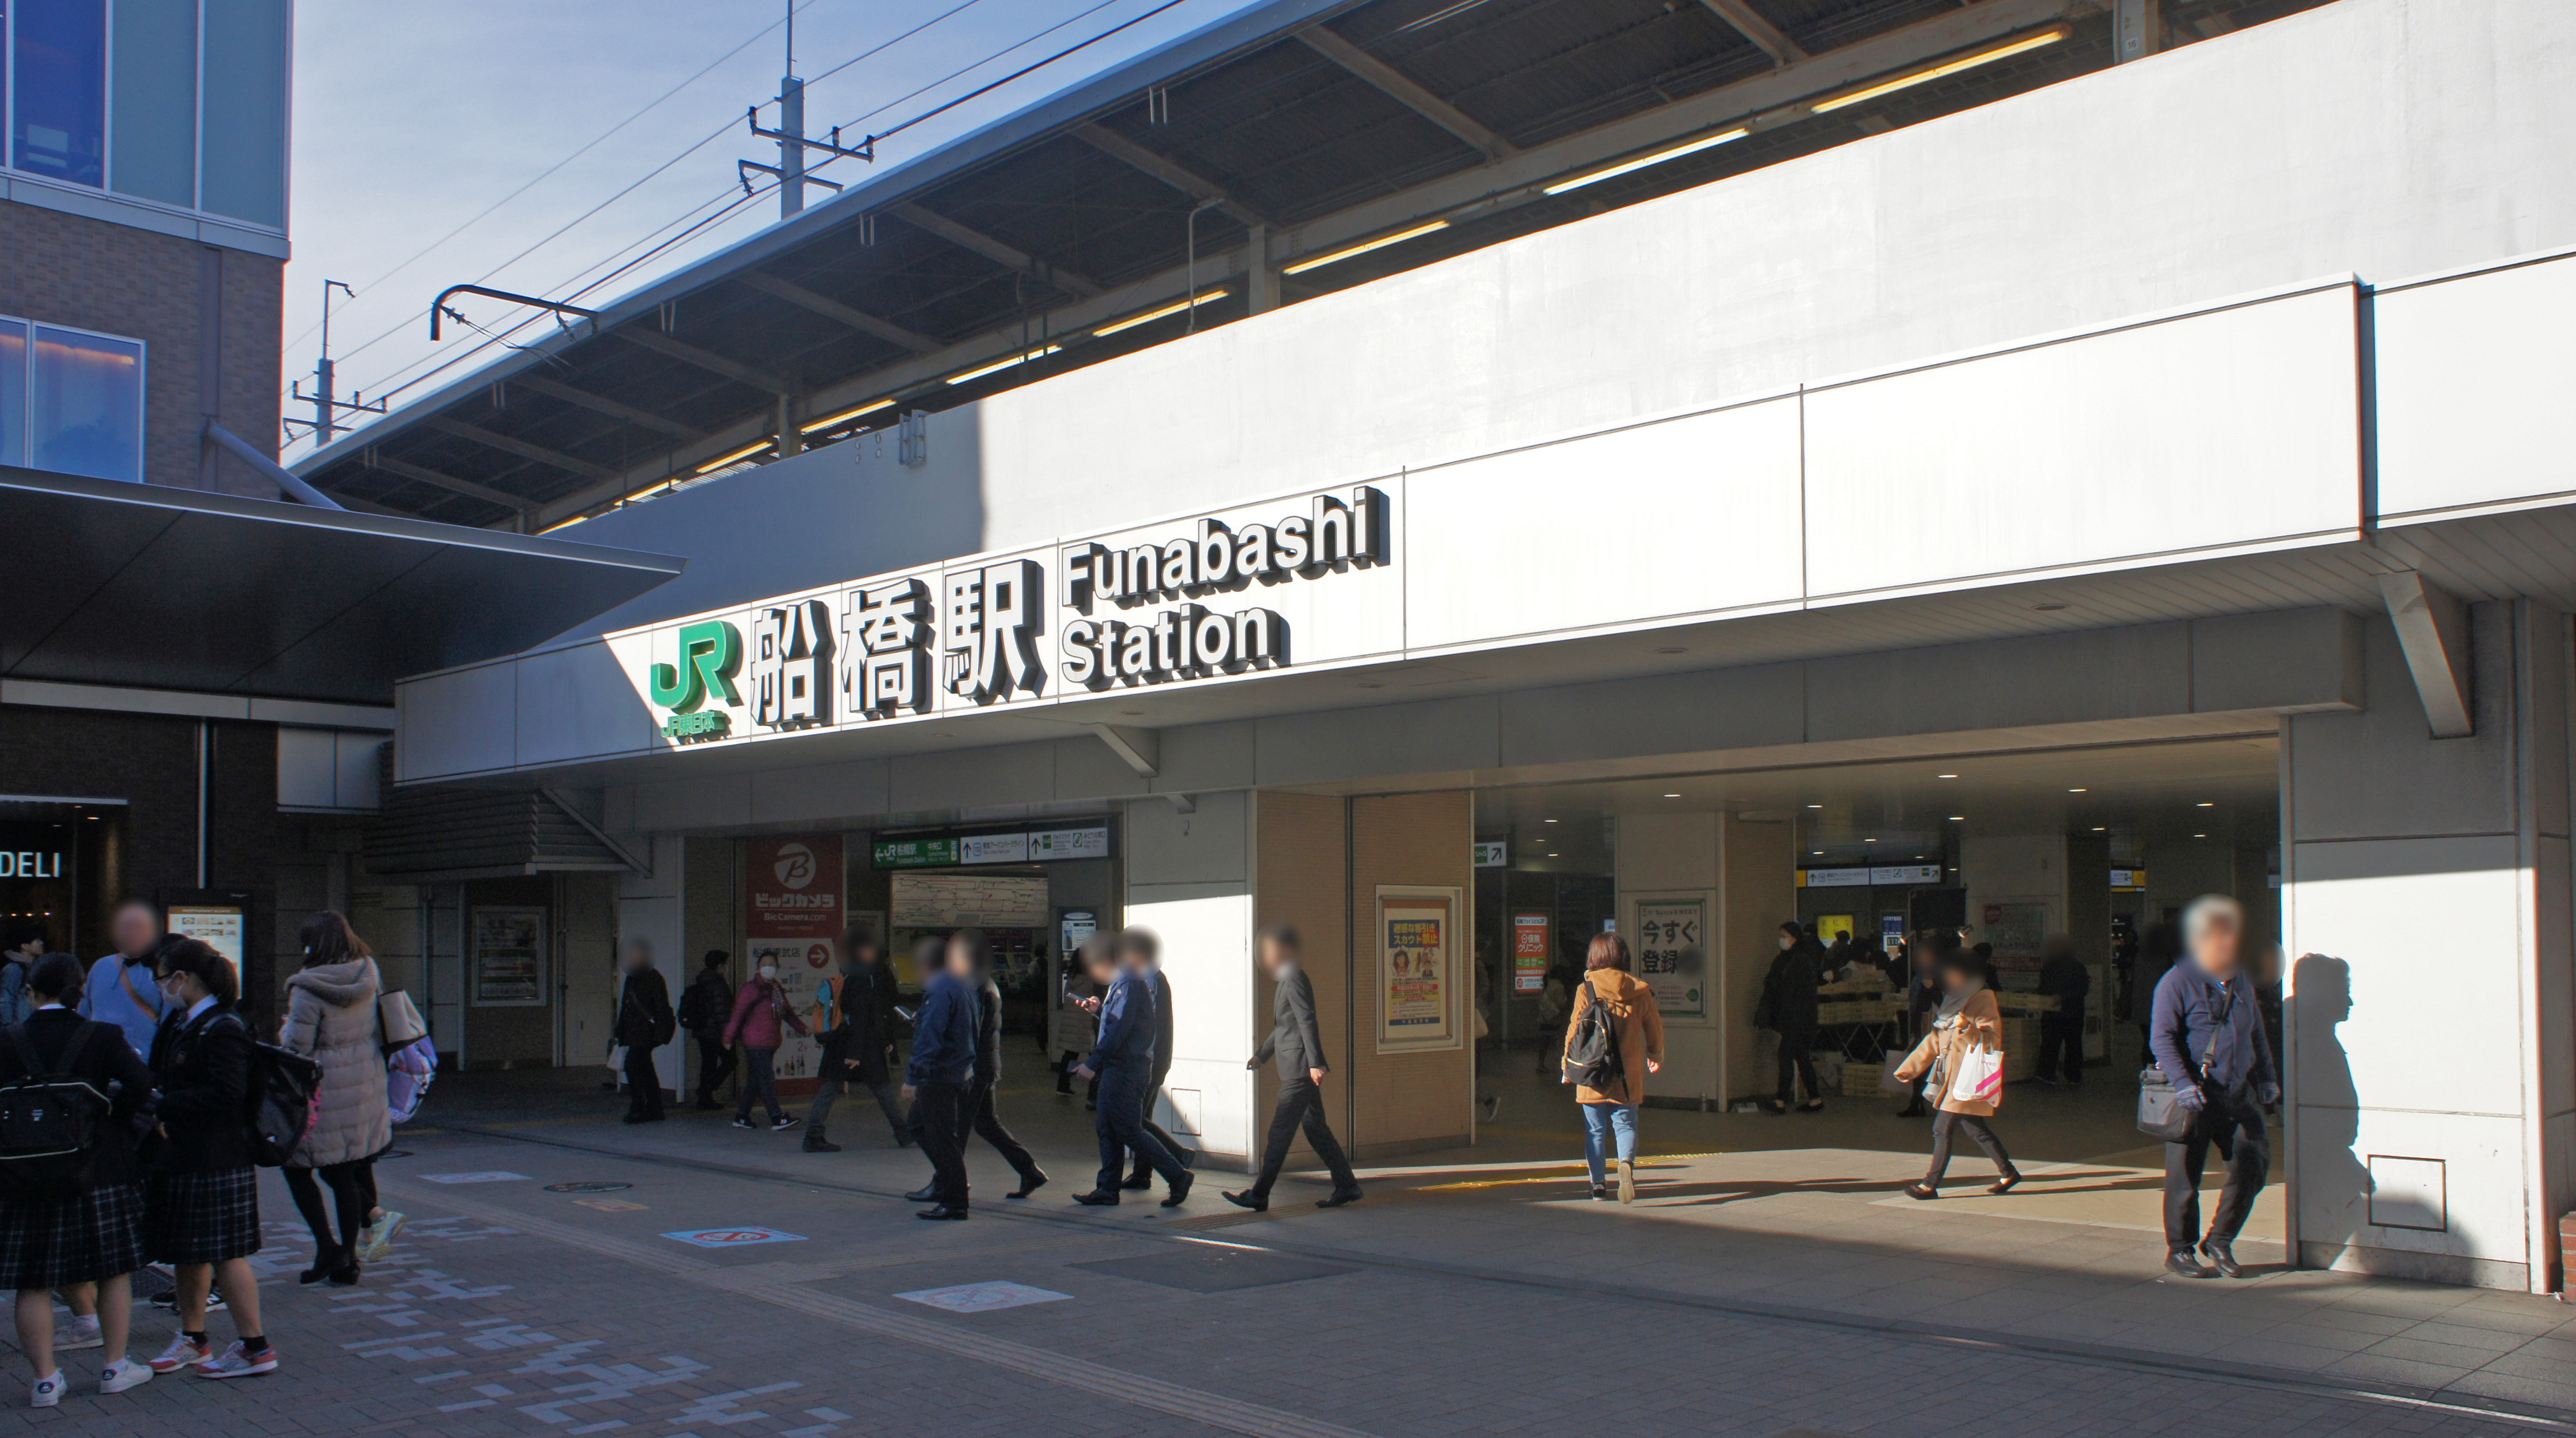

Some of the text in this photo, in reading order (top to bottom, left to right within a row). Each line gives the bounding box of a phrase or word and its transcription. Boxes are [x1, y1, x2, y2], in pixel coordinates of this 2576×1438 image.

[1061, 484, 1371, 610] Funabashi
[751, 559, 1041, 726] 船橋駅
[1061, 602, 1273, 687] Station
[650, 620, 732, 708] JR
[660, 711, 717, 738] JR東日本
[884, 845, 896, 857] JR
[897, 843, 916, 856] 船橋駅
[0, 851, 62, 877] DELI
[756, 892, 835, 908] ビックカメラ
[764, 912, 827, 921] BicCamera.com
[1394, 923, 1436, 934] 迷惑な客引き
[1642, 919, 1698, 944] 今すぐ
[1394, 934, 1438, 944] スカウト禁止
[1528, 934, 1541, 943] 保険
[1518, 944, 1544, 952] クリニック
